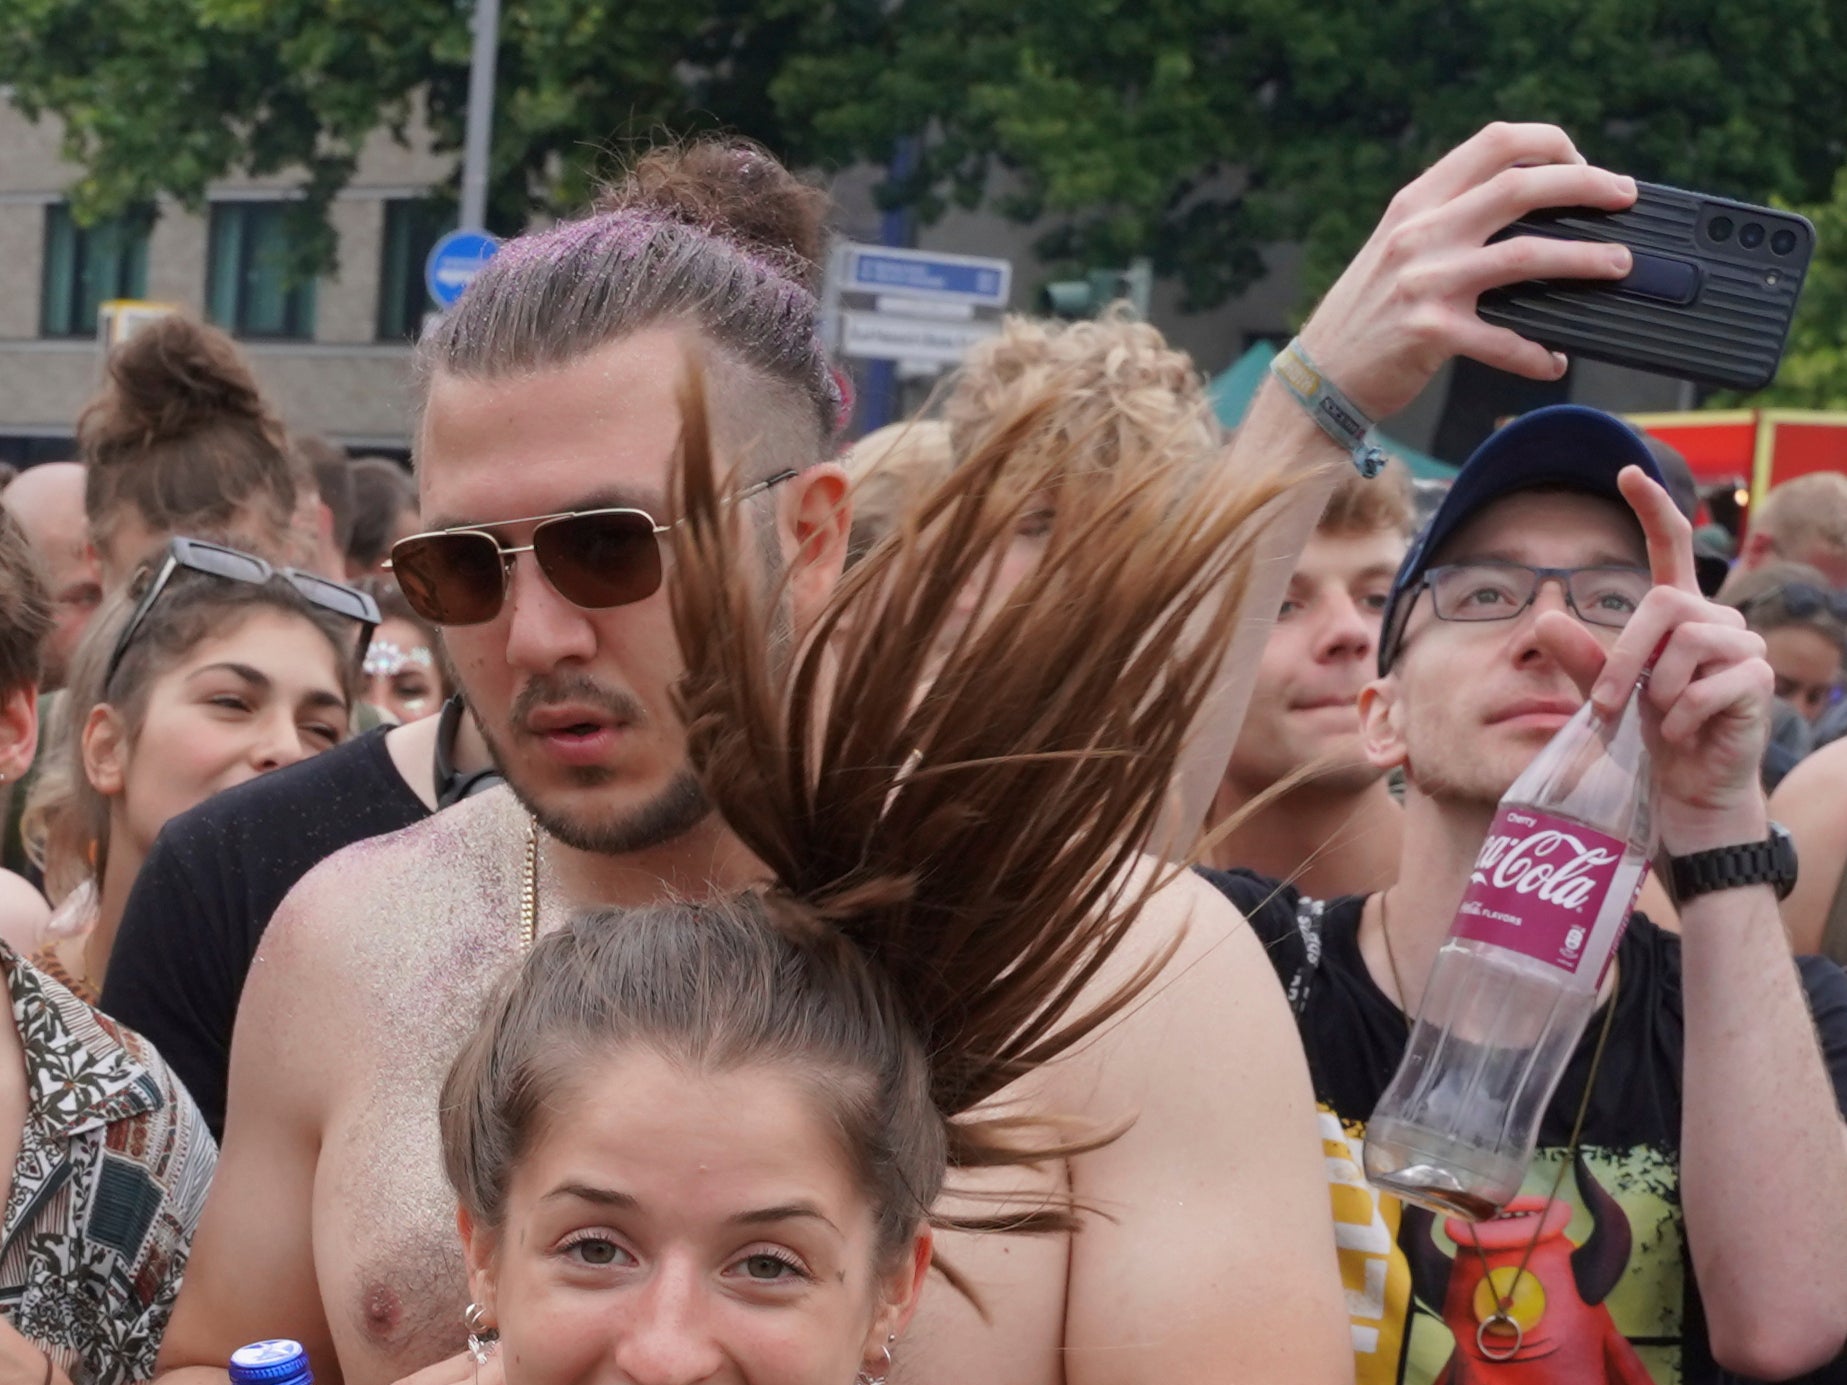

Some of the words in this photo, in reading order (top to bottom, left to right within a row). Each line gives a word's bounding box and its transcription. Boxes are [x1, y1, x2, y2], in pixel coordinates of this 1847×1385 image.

[1507, 812, 1537, 828] Cherry
[1470, 830, 1619, 909] ca-Cola
[1482, 908, 1522, 926] FLAVORS
